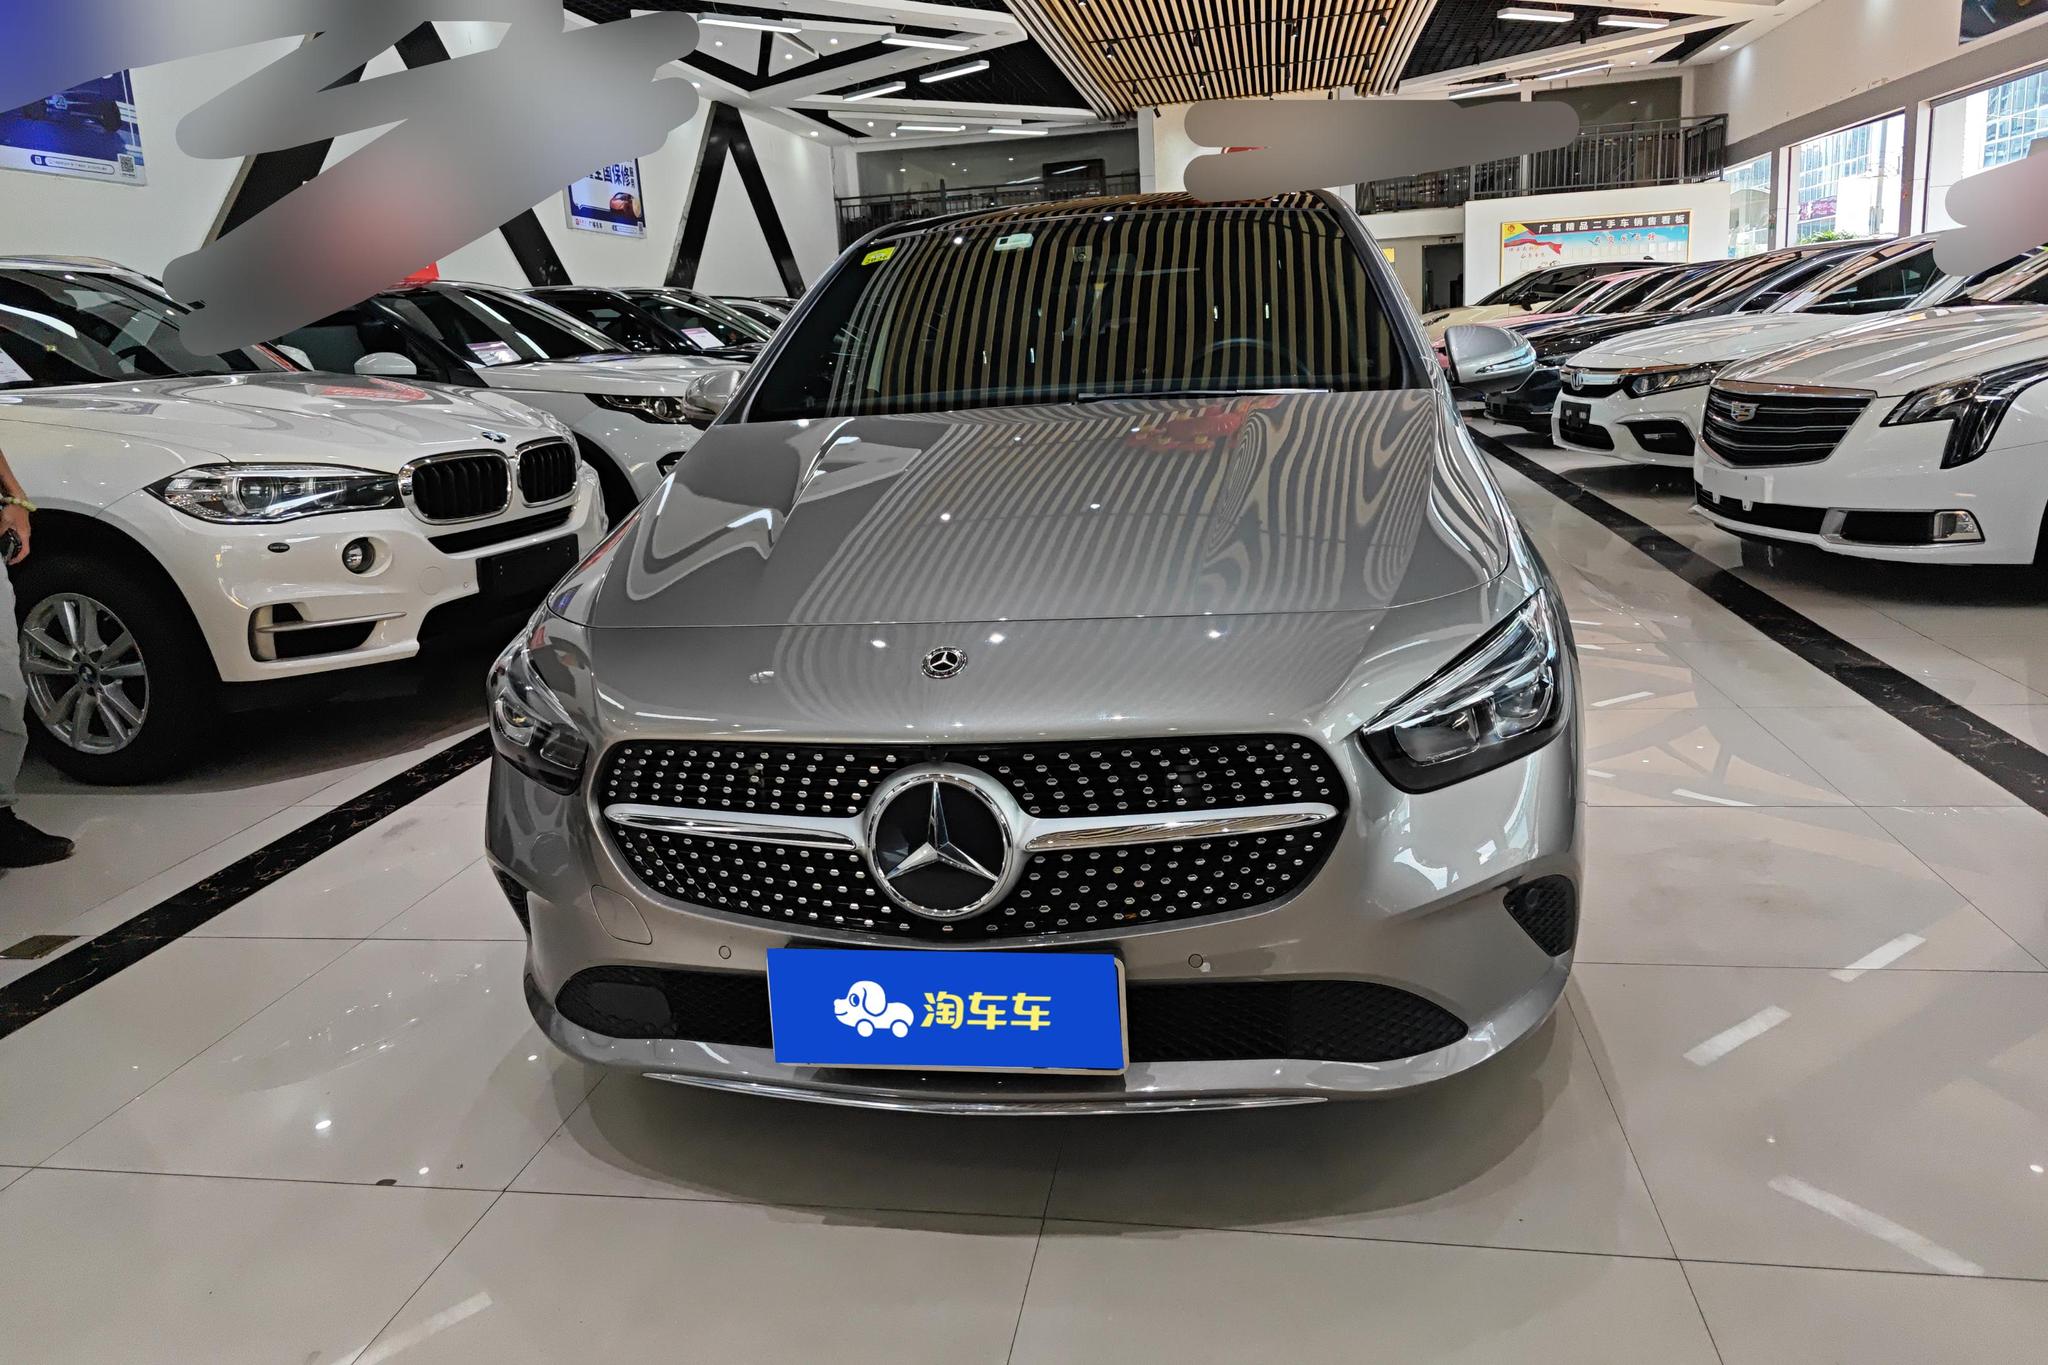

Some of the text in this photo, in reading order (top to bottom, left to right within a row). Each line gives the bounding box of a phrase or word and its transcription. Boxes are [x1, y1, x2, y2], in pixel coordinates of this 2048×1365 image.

[1538, 214, 1686, 233] 广福精品二手车销售看板
